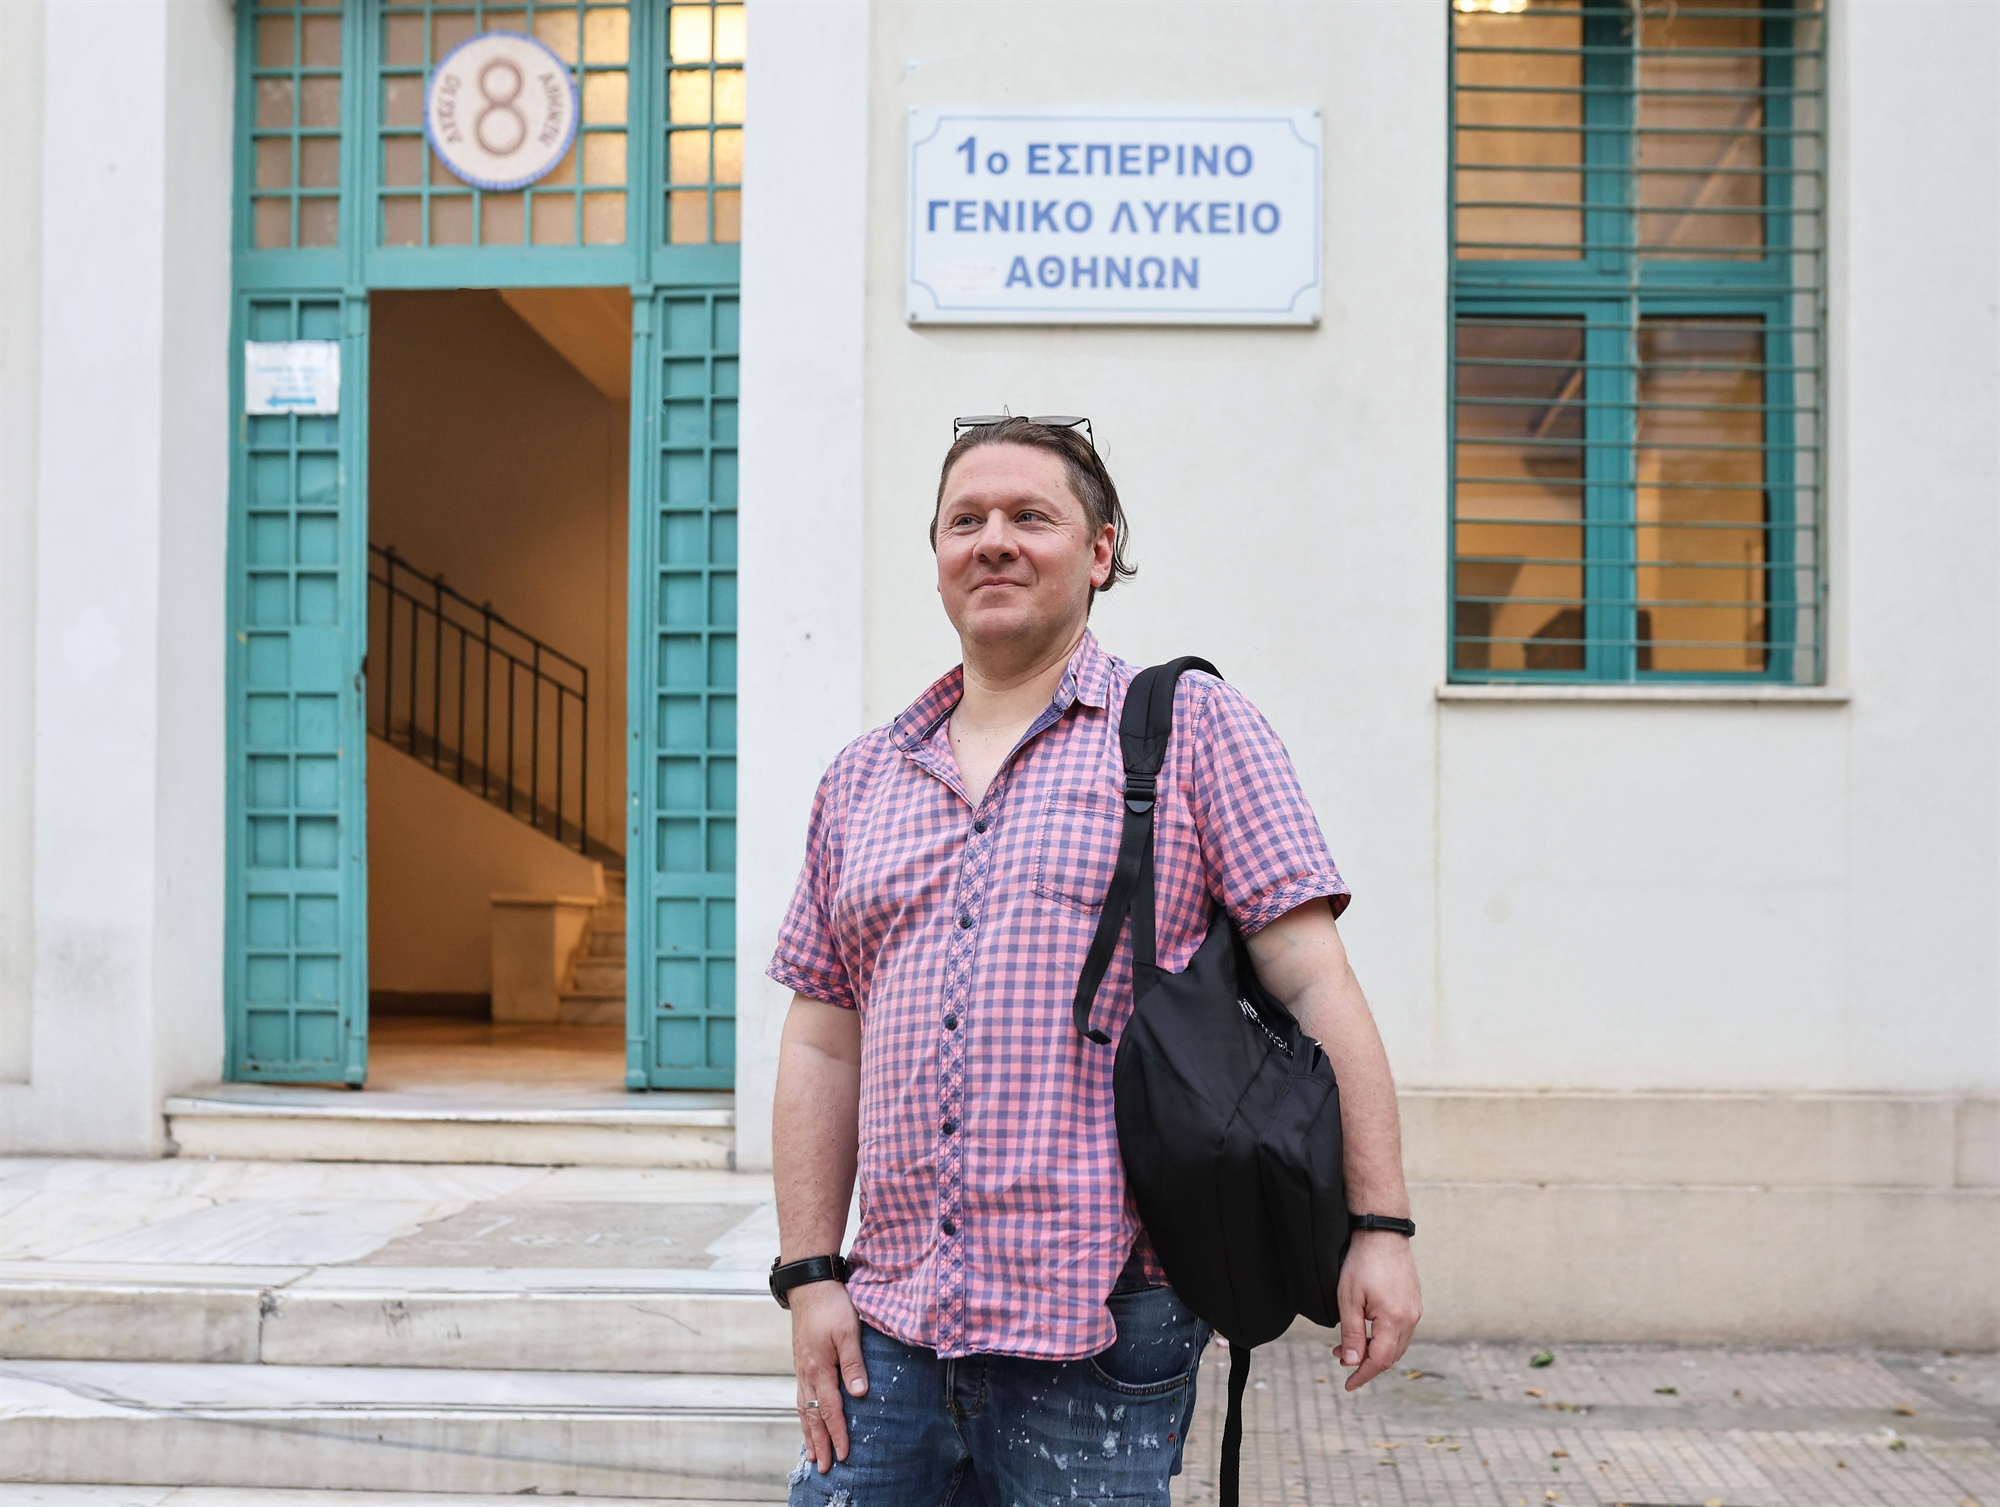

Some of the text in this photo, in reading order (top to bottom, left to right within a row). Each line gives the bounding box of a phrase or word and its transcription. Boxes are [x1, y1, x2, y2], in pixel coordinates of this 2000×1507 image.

[475, 54, 527, 157] 8
[1027, 143, 1253, 177] ΕΣΠΕΡΙΝΟ
[928, 200, 1281, 234] ΓΕΝΙΚΟ ΛΥΚΕΙΟ
[1006, 255, 1199, 289] ΑΘΗΝΩΝ
